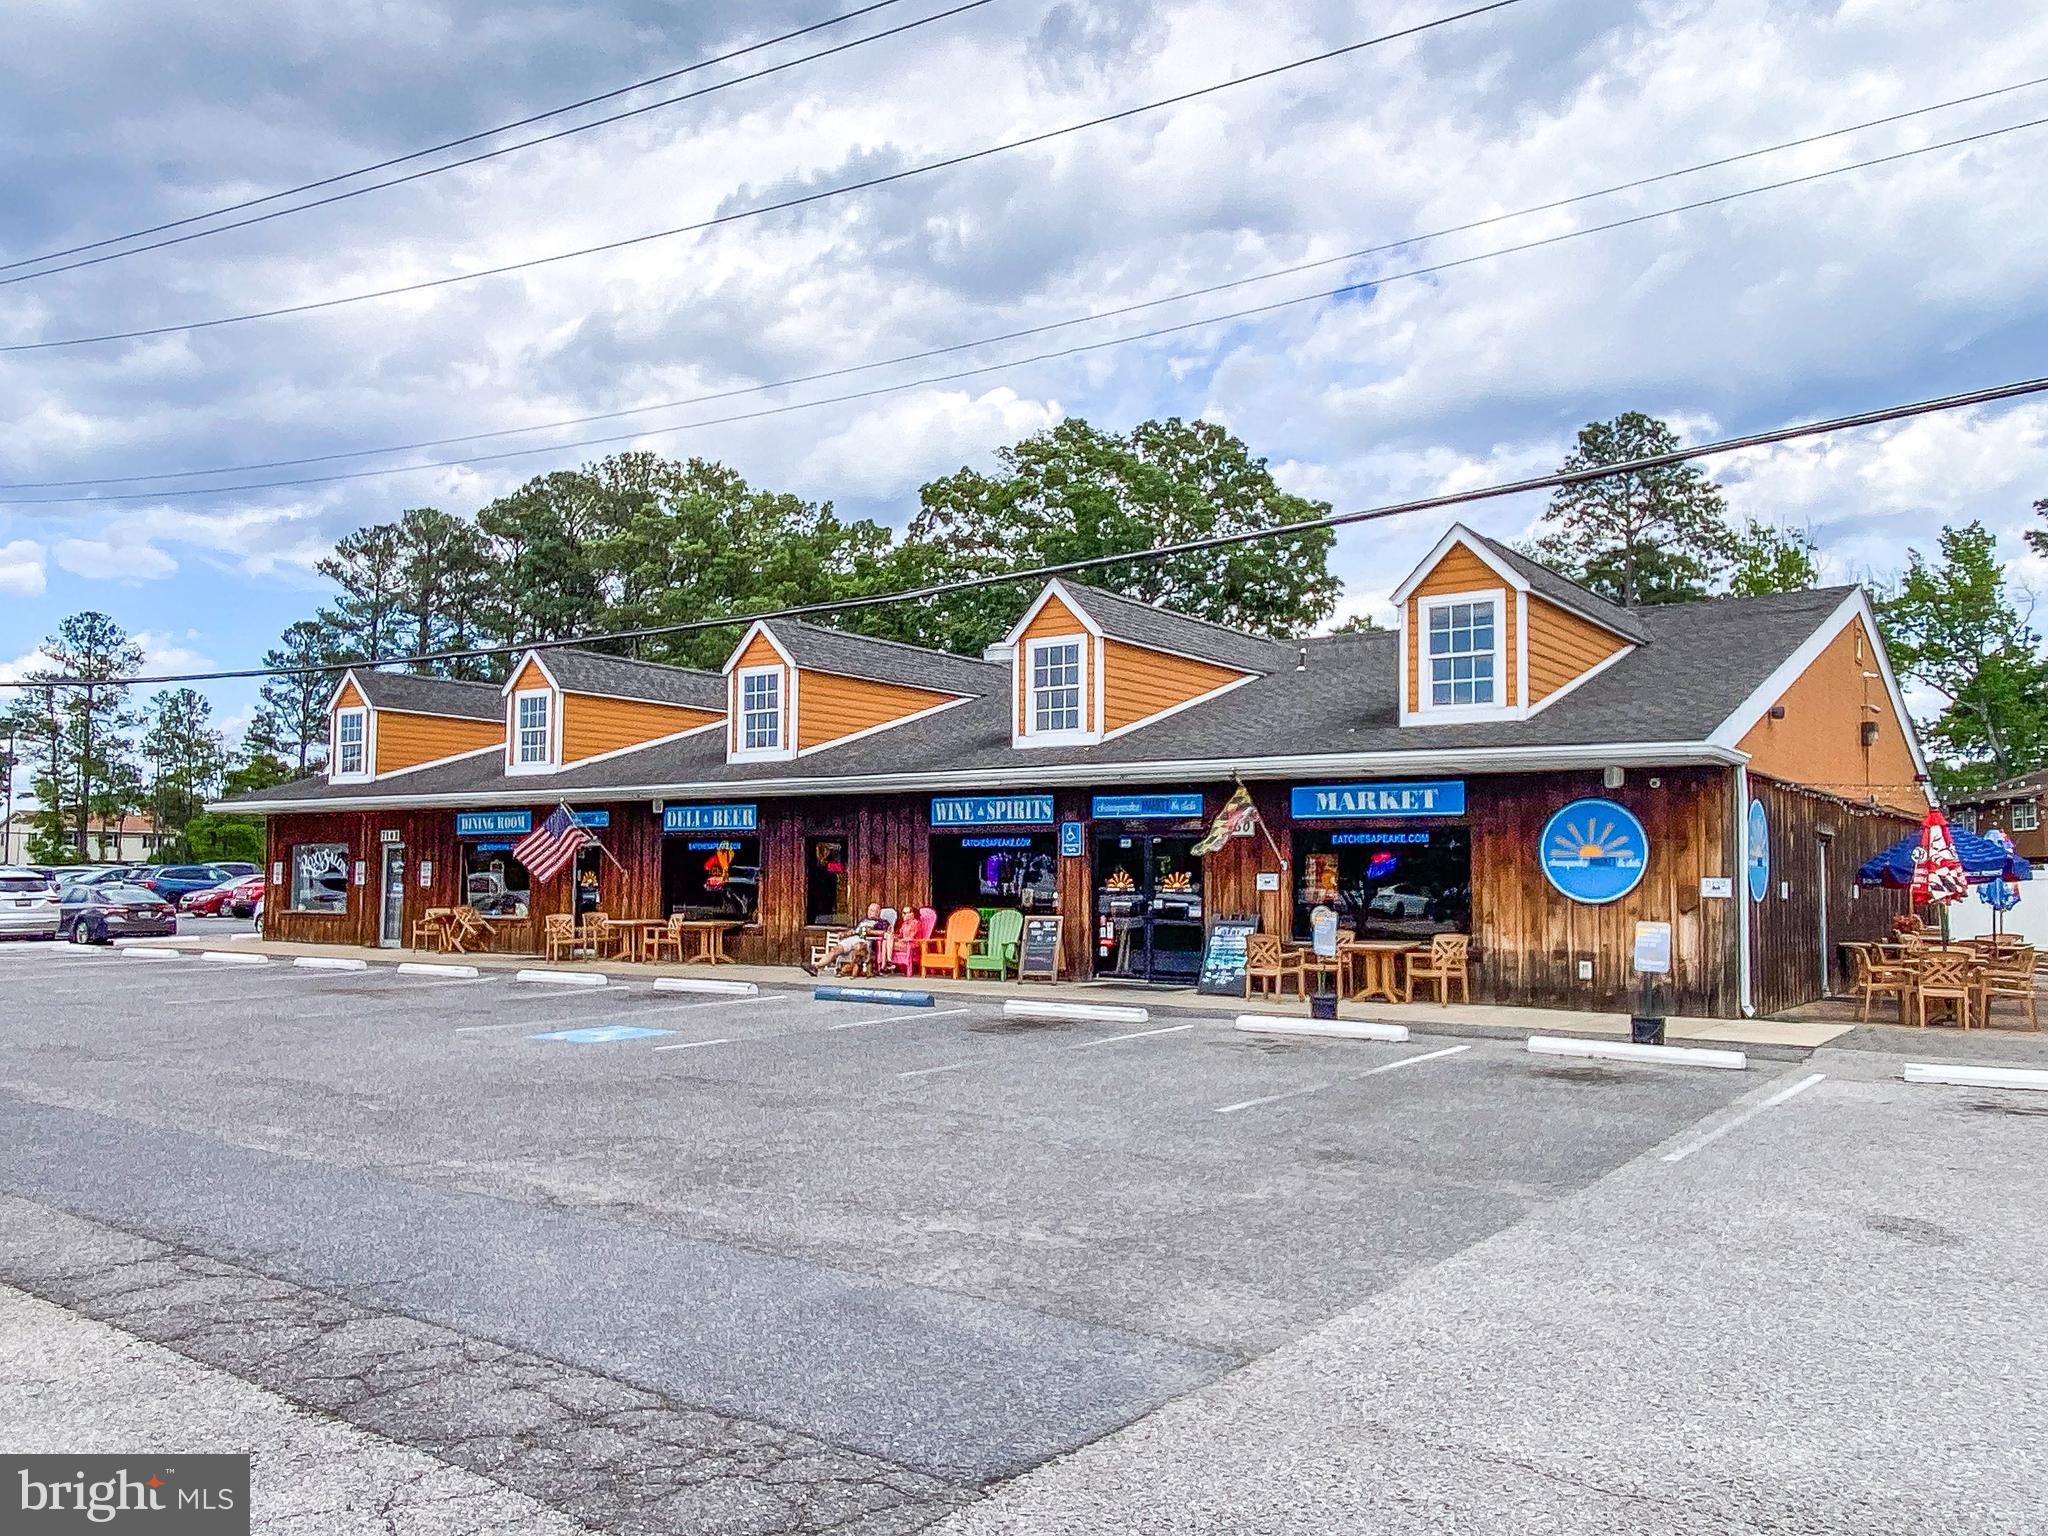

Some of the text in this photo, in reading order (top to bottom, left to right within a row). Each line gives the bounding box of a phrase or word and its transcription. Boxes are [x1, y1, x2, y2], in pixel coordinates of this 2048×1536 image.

[935, 801, 974, 821] WINE
[986, 799, 1053, 820] SPIRITS
[1315, 788, 1439, 812] MARKET
[461, 815, 526, 830] DINING ROOM
[667, 810, 700, 828] DELI
[713, 808, 753, 827] BEER
[1331, 833, 1430, 845] EATCHESAPEAKE.COM
